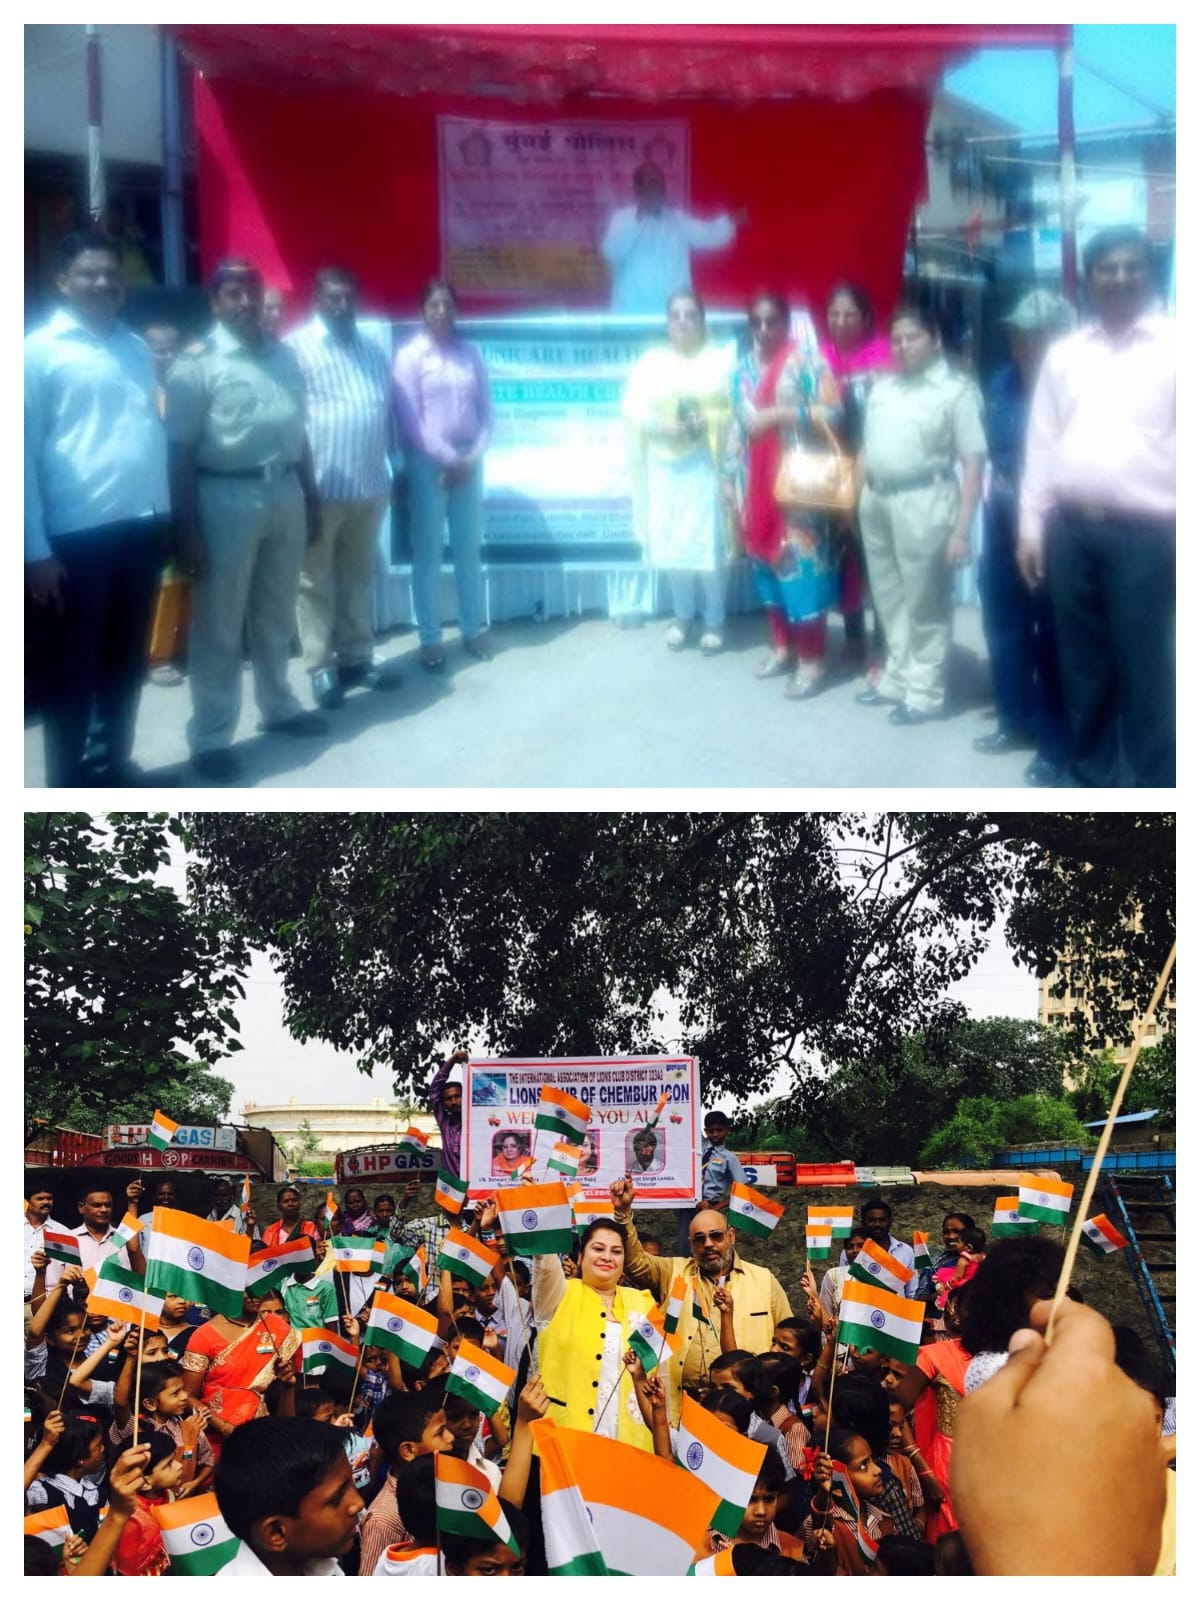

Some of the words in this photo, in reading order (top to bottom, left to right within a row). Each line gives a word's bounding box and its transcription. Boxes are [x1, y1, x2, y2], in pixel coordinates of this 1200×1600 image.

[508, 1072, 519, 1084] THE
[519, 1072, 556, 1084] INTERNATIONAL
[557, 1071, 589, 1083] ASSOCIATION
[589, 1071, 596, 1082] OF
[597, 1071, 612, 1082] LIONS
[612, 1070, 625, 1082] CLUB
[625, 1070, 648, 1082] DISTRICT
[581, 1086, 596, 1103] OF
[600, 1085, 657, 1103] CHEMBUR
[597, 1110, 630, 1124] YOU
[176, 1128, 212, 1146] GAS
[363, 1155, 391, 1171] HP
[395, 1154, 434, 1169] GAS
